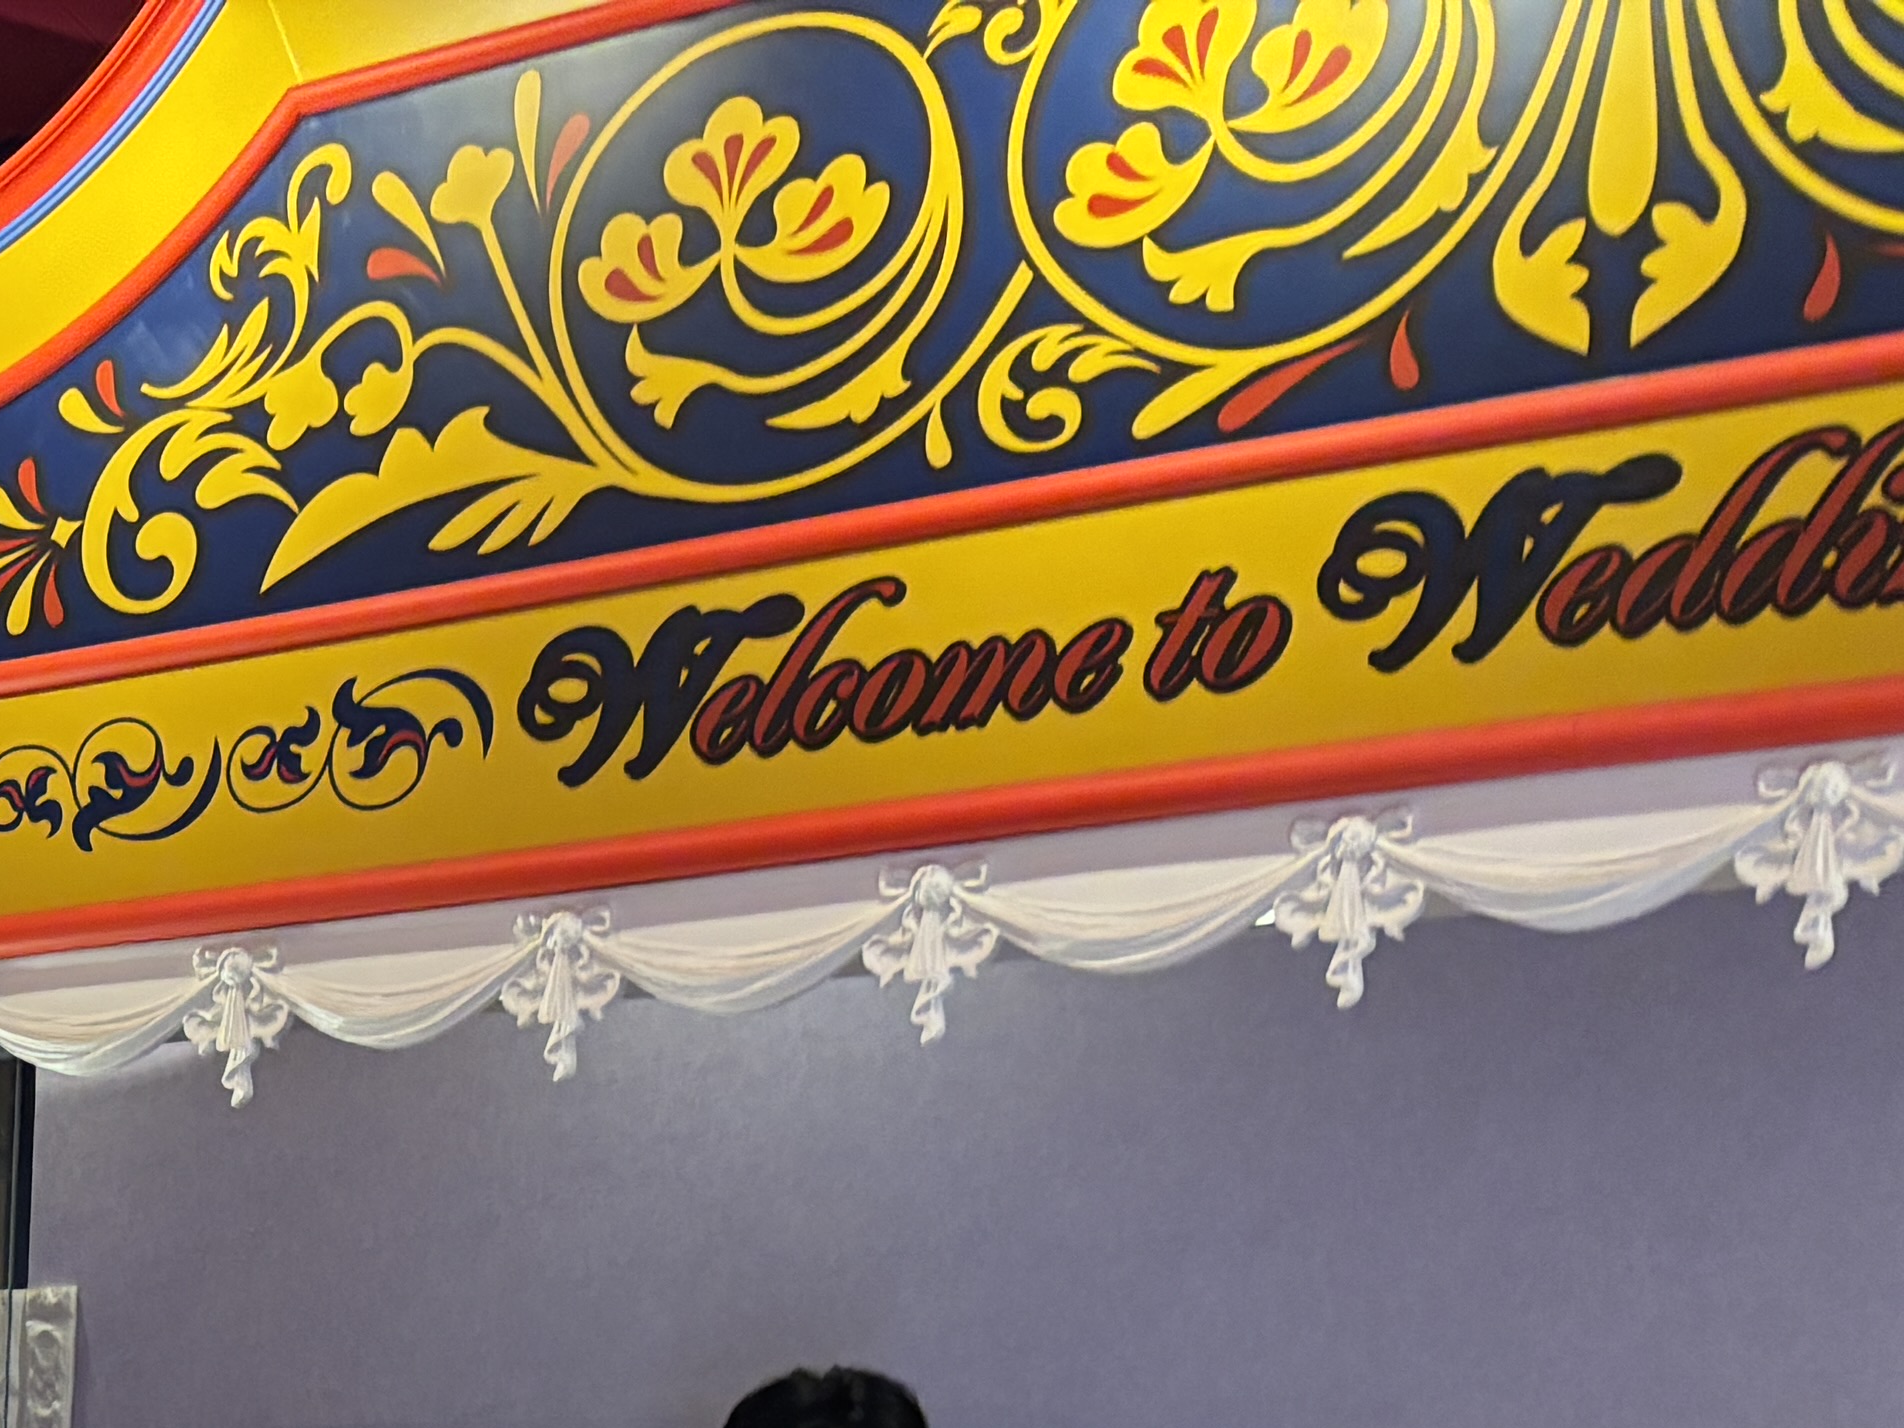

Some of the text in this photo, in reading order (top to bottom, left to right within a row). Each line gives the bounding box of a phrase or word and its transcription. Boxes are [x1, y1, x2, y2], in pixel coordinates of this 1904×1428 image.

[517, 416, 1904, 788] Welcome to Weddi
